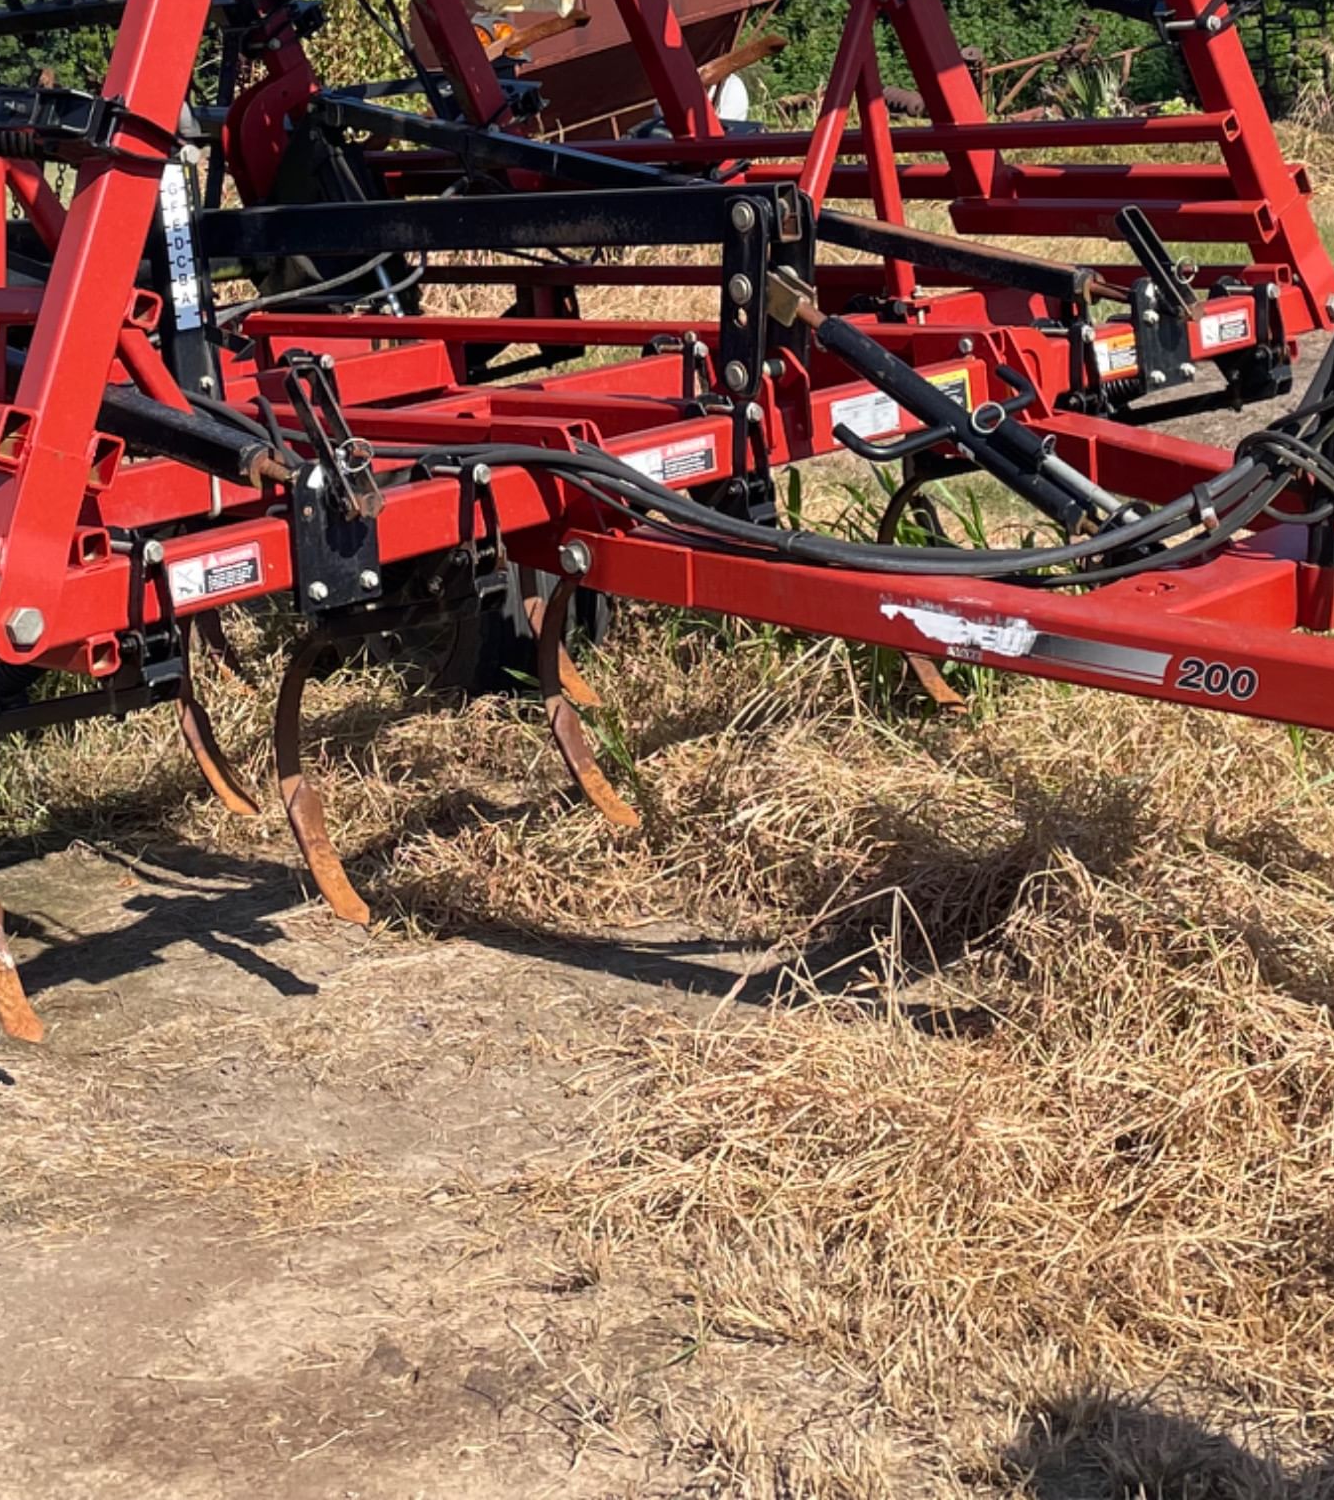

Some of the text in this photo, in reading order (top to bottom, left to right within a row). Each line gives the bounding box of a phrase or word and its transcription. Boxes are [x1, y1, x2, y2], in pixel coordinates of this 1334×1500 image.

[168, 183, 178, 196] G
[170, 200, 179, 212] F
[172, 218, 182, 232] E
[174, 237, 184, 250] D
[176, 256, 186, 268] C
[178, 273, 188, 286] B
[182, 293, 191, 304] A
[1175, 656, 1259, 701] 200
